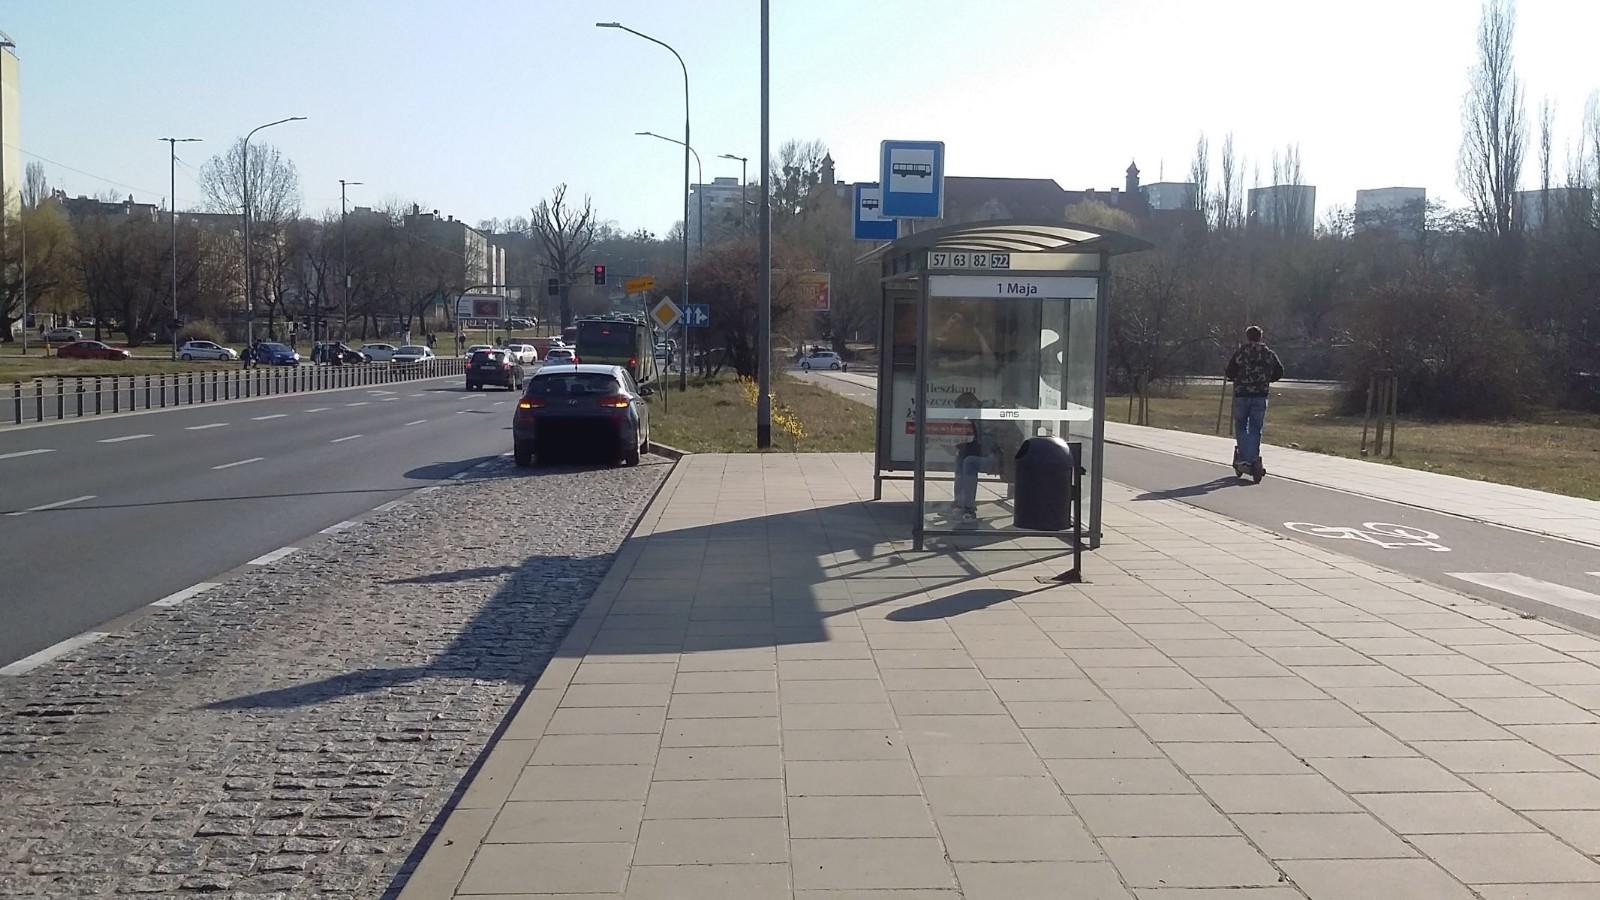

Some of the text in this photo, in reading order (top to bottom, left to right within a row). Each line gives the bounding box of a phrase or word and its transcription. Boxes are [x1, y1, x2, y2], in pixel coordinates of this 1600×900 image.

[933, 253, 1009, 268] 57 63 82 522
[997, 283, 1038, 297] 1 Maja
[999, 410, 1020, 418] ams
